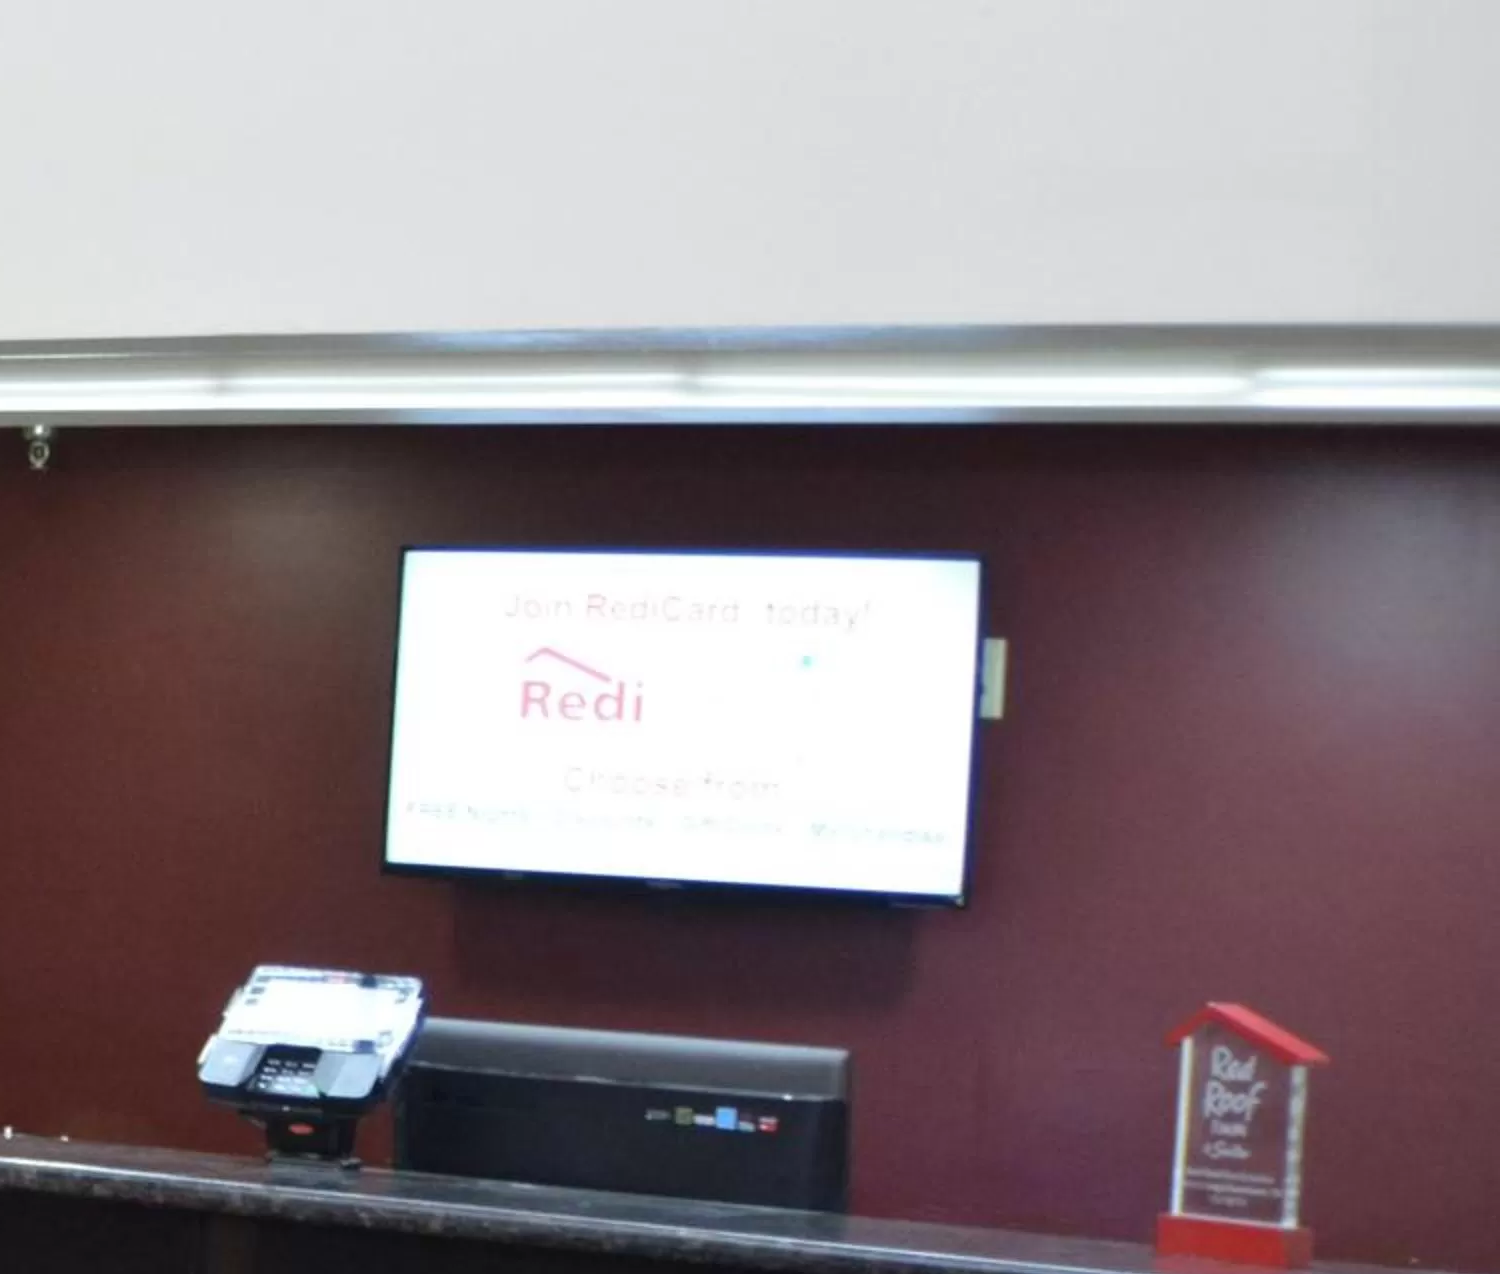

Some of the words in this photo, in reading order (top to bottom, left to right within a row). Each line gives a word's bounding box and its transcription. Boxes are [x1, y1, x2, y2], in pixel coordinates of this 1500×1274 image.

[503, 593, 573, 621] Join
[585, 592, 741, 625] RediCard
[764, 599, 872, 634] today!
[518, 678, 646, 725] Redi
[563, 764, 691, 798] Choose
[1211, 1044, 1258, 1082] Red
[1203, 1079, 1269, 1121] Roof
